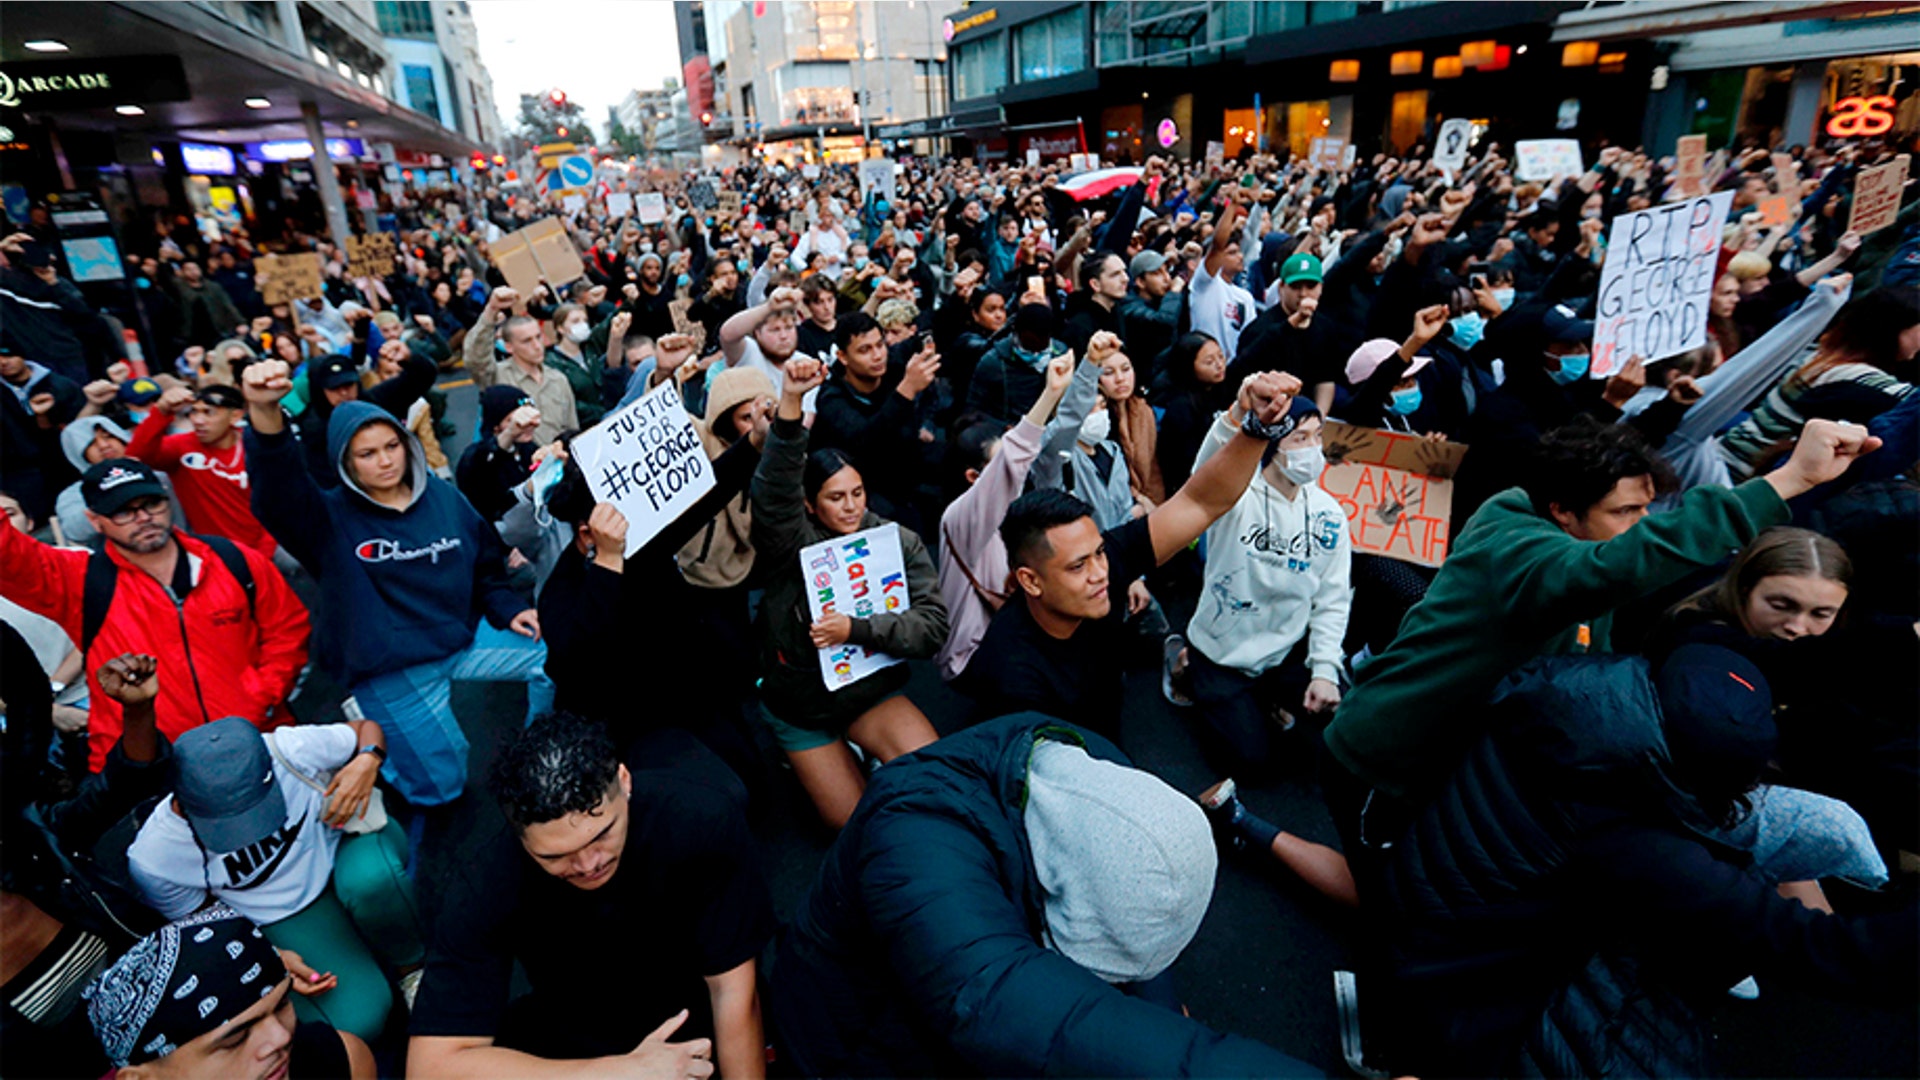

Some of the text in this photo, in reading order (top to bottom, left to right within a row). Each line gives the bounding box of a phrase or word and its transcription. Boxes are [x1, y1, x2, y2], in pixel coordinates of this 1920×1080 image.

[1625, 198, 1713, 269] RIP
[1601, 250, 1715, 317] GEORGE
[1614, 302, 1698, 367] FLOYD
[600, 423, 700, 501] #GEORGE
[638, 416, 677, 453] FOR
[1361, 431, 1414, 470] I
[646, 456, 702, 512] FLOYD
[1339, 498, 1447, 563] REATH
[842, 537, 874, 618] Mana
